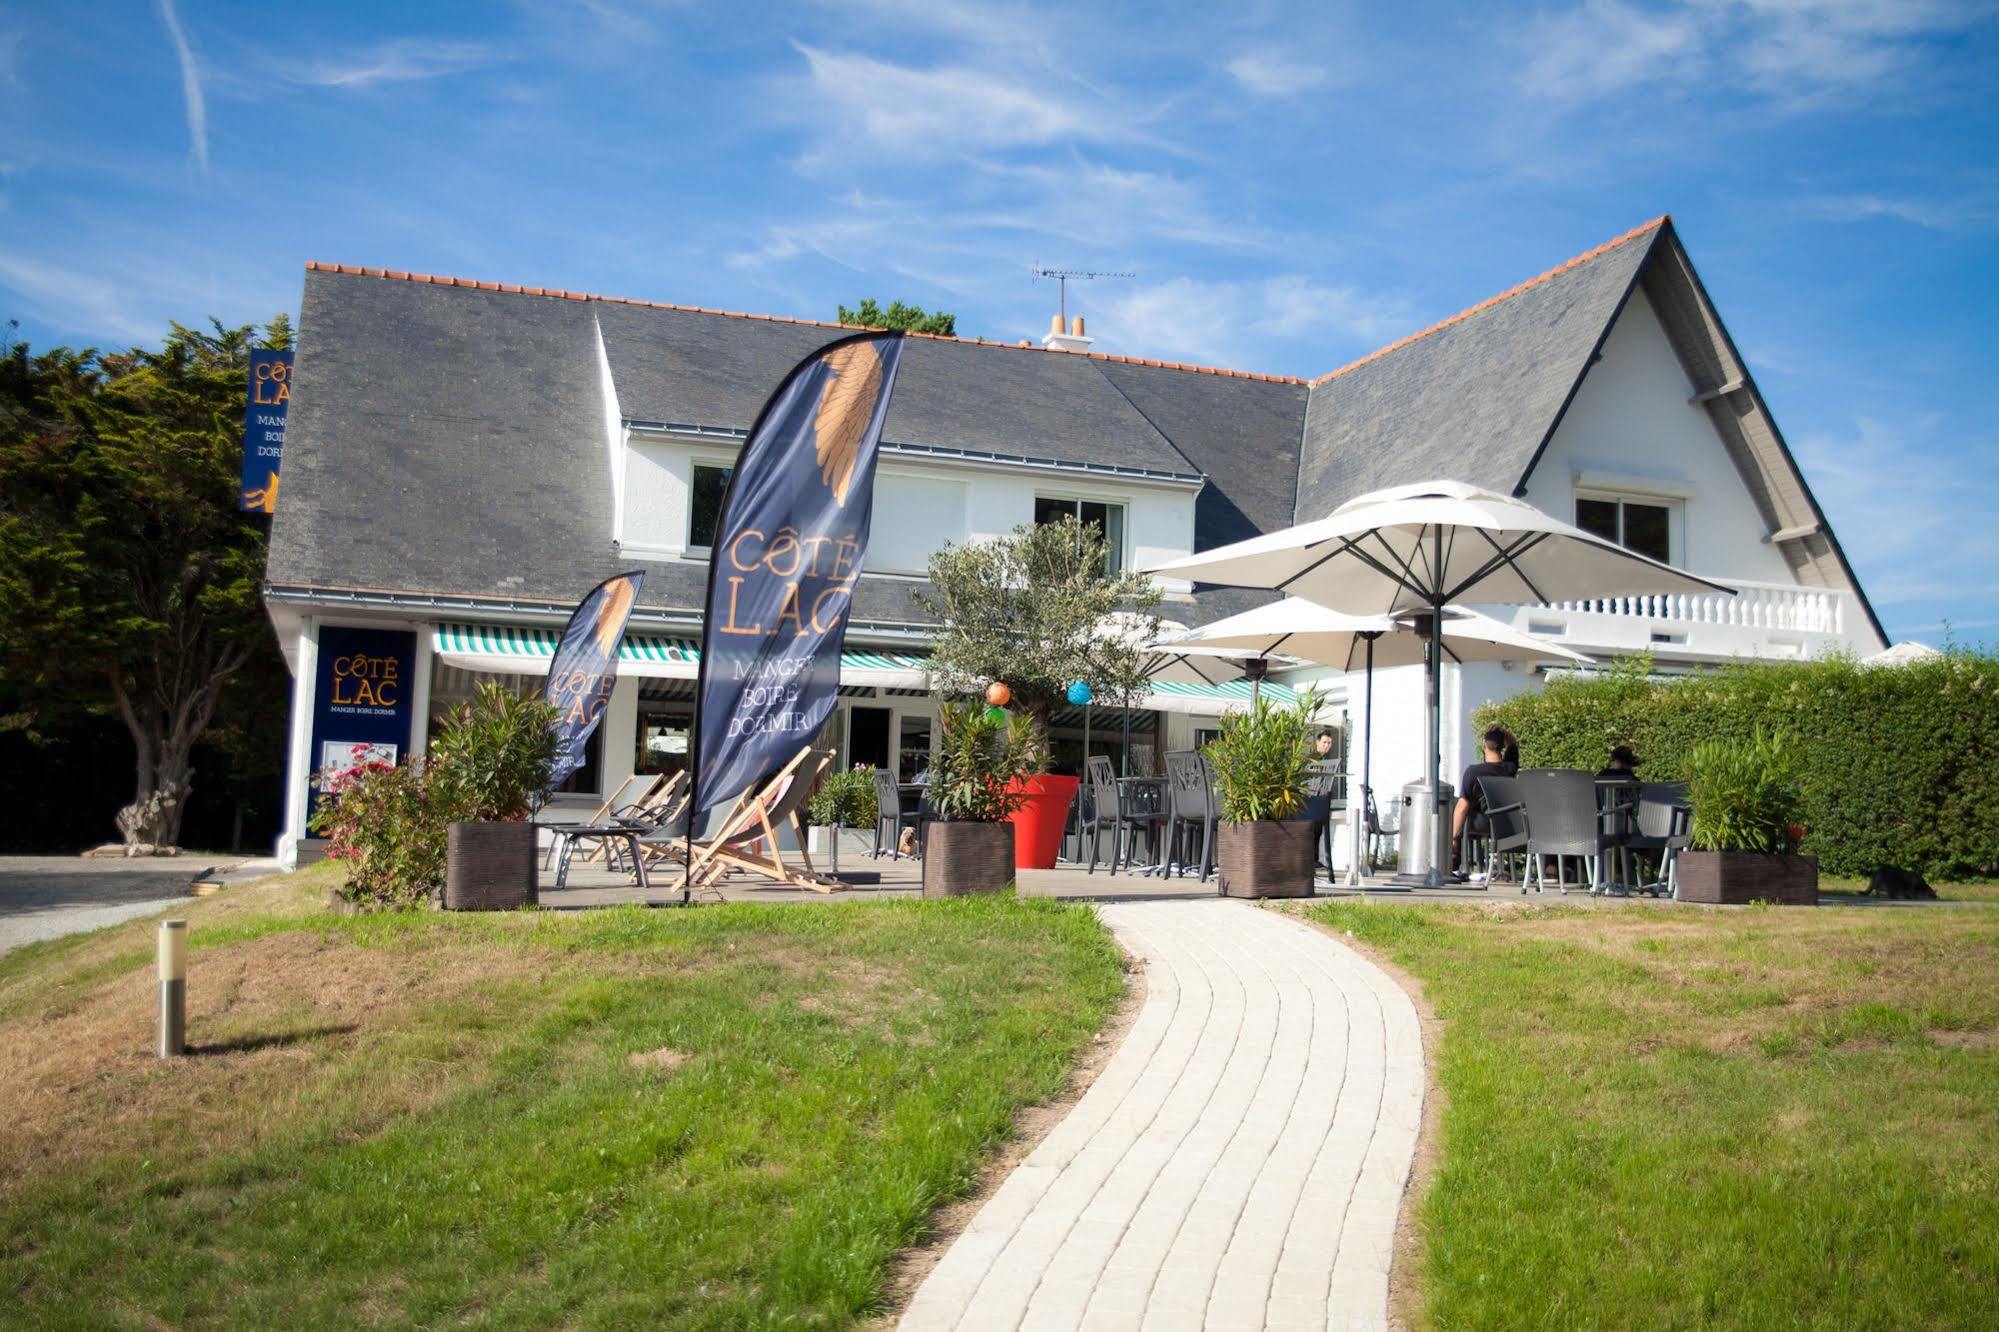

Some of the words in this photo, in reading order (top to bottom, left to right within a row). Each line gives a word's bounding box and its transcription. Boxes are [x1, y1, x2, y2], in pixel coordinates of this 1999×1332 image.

[254, 381, 291, 405] LA
[257, 414, 288, 428] MAN
[257, 445, 283, 457] DOR
[730, 526, 859, 581] CÔTÉ
[719, 576, 851, 637] LAC
[334, 653, 399, 679] CÔTÉ
[331, 677, 397, 706] LAC
[741, 683, 799, 708] BOIRE
[727, 712, 809, 738] DORMIR
